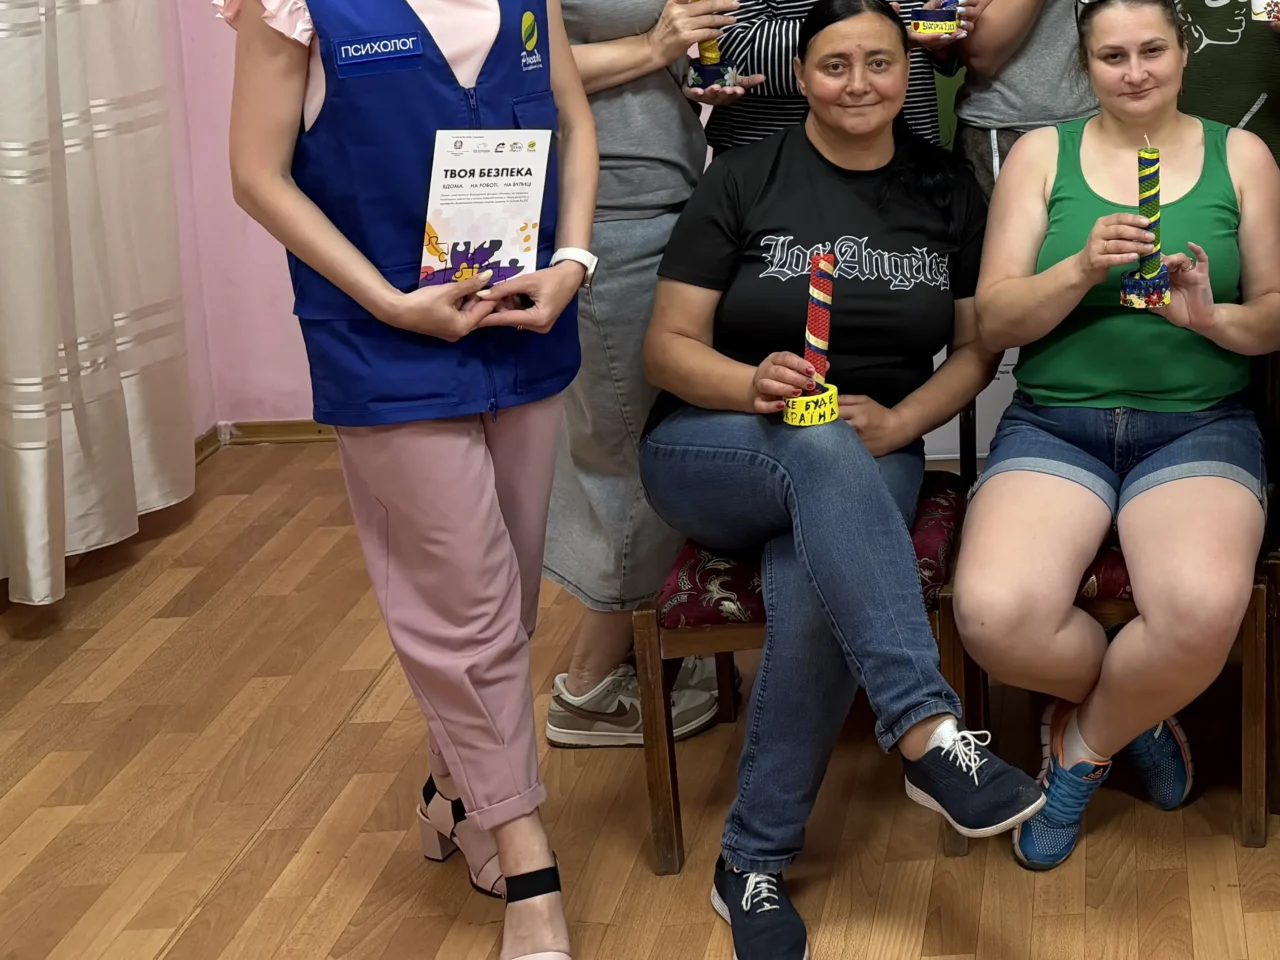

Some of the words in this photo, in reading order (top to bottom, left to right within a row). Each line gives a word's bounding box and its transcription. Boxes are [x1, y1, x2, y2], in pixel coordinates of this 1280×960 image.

[341, 37, 417, 59] ПСИХОЛОГ
[443, 168, 476, 179] ТВОЯ
[479, 167, 533, 178] БЕЗПЕКА
[833, 235, 950, 291] Angeles
